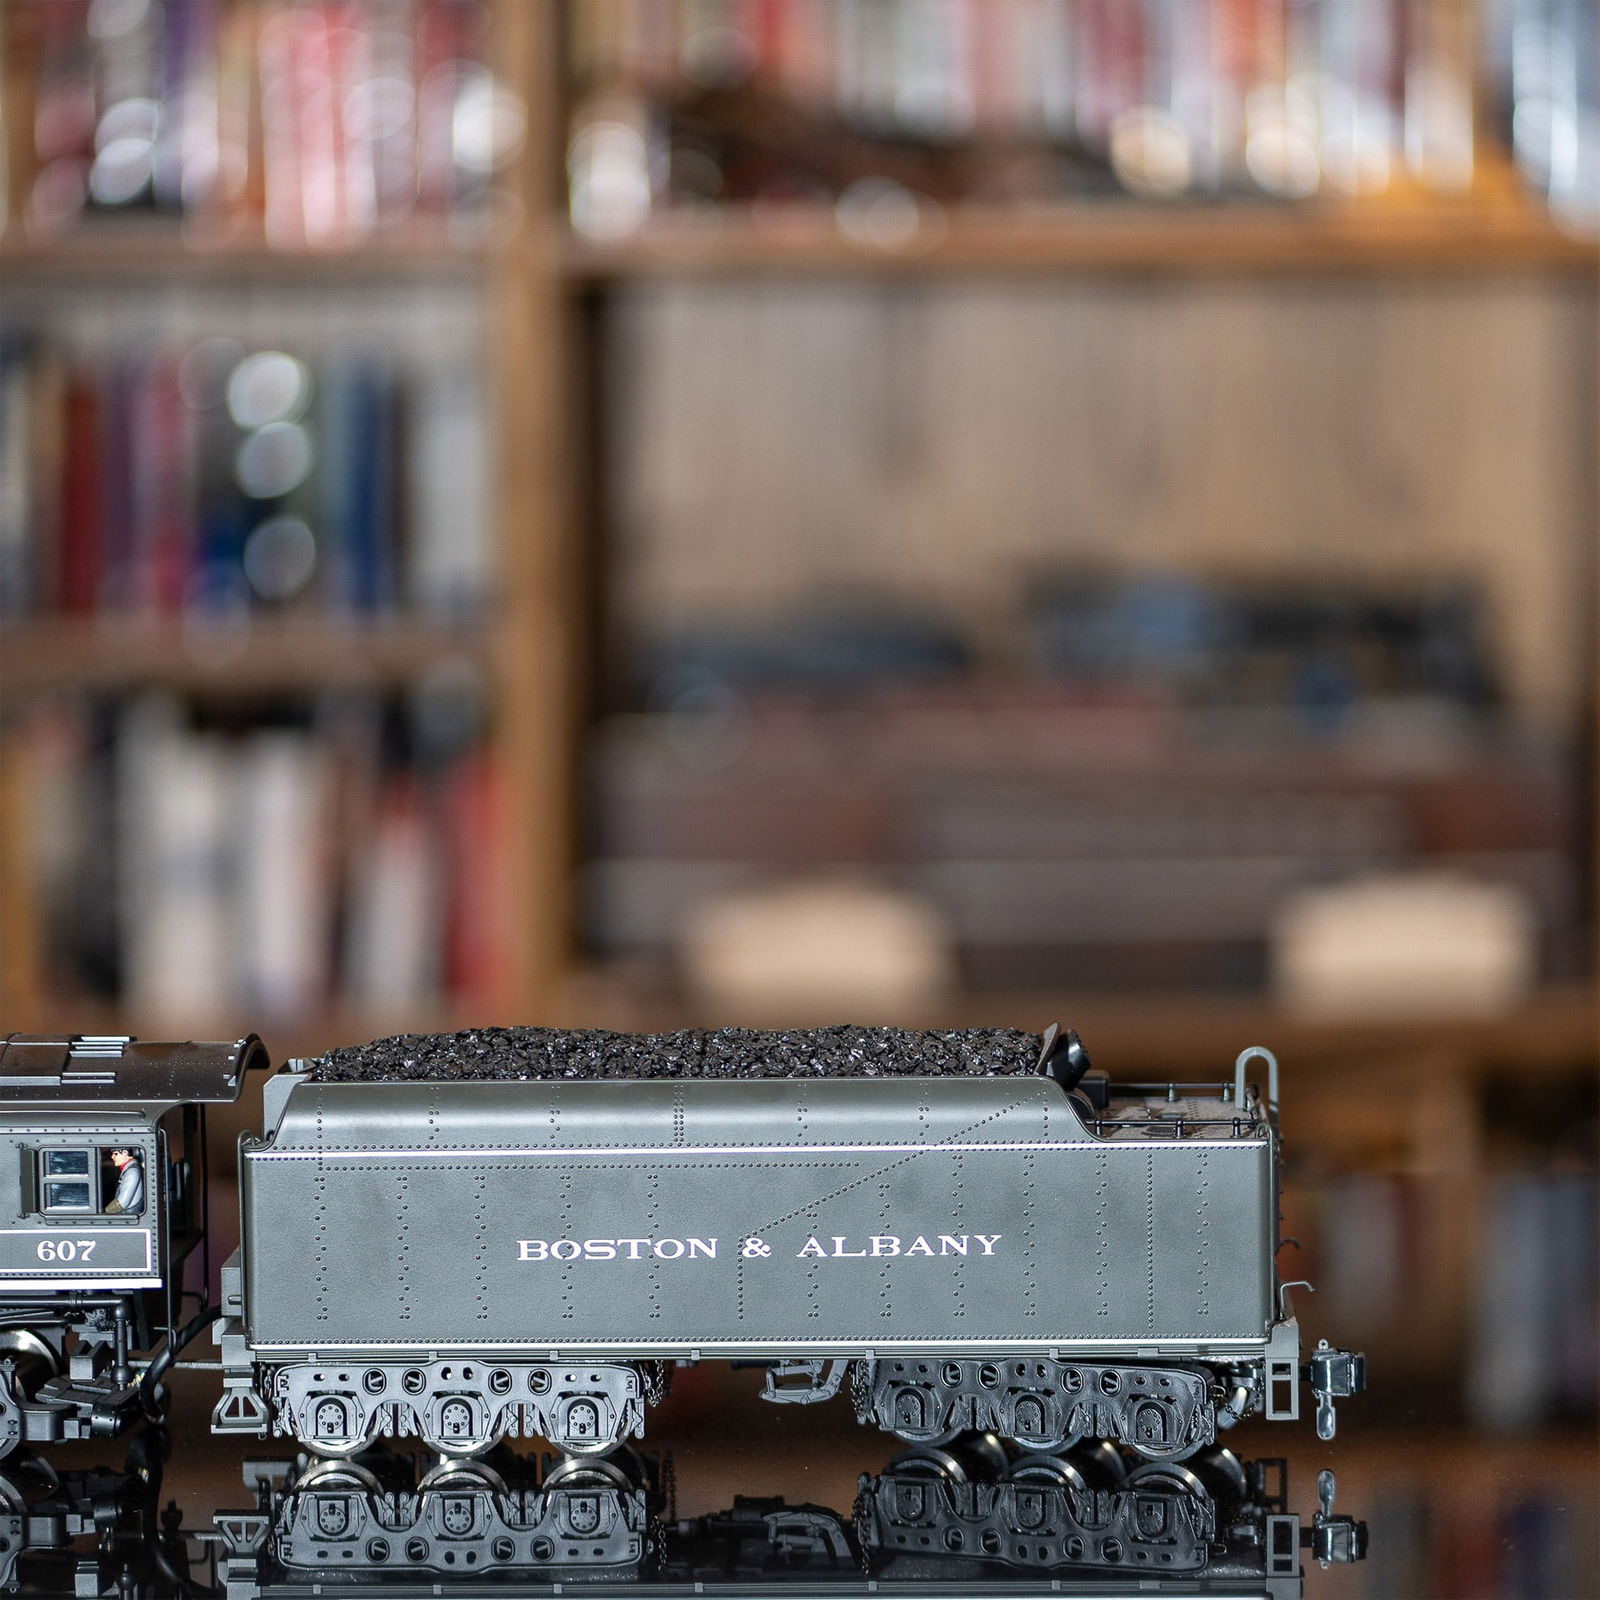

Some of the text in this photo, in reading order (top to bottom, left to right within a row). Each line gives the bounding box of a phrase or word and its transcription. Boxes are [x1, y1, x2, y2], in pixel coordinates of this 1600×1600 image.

[36, 1240, 97, 1262] 607
[516, 1234, 1002, 1261] BOSTON & ALBANY
